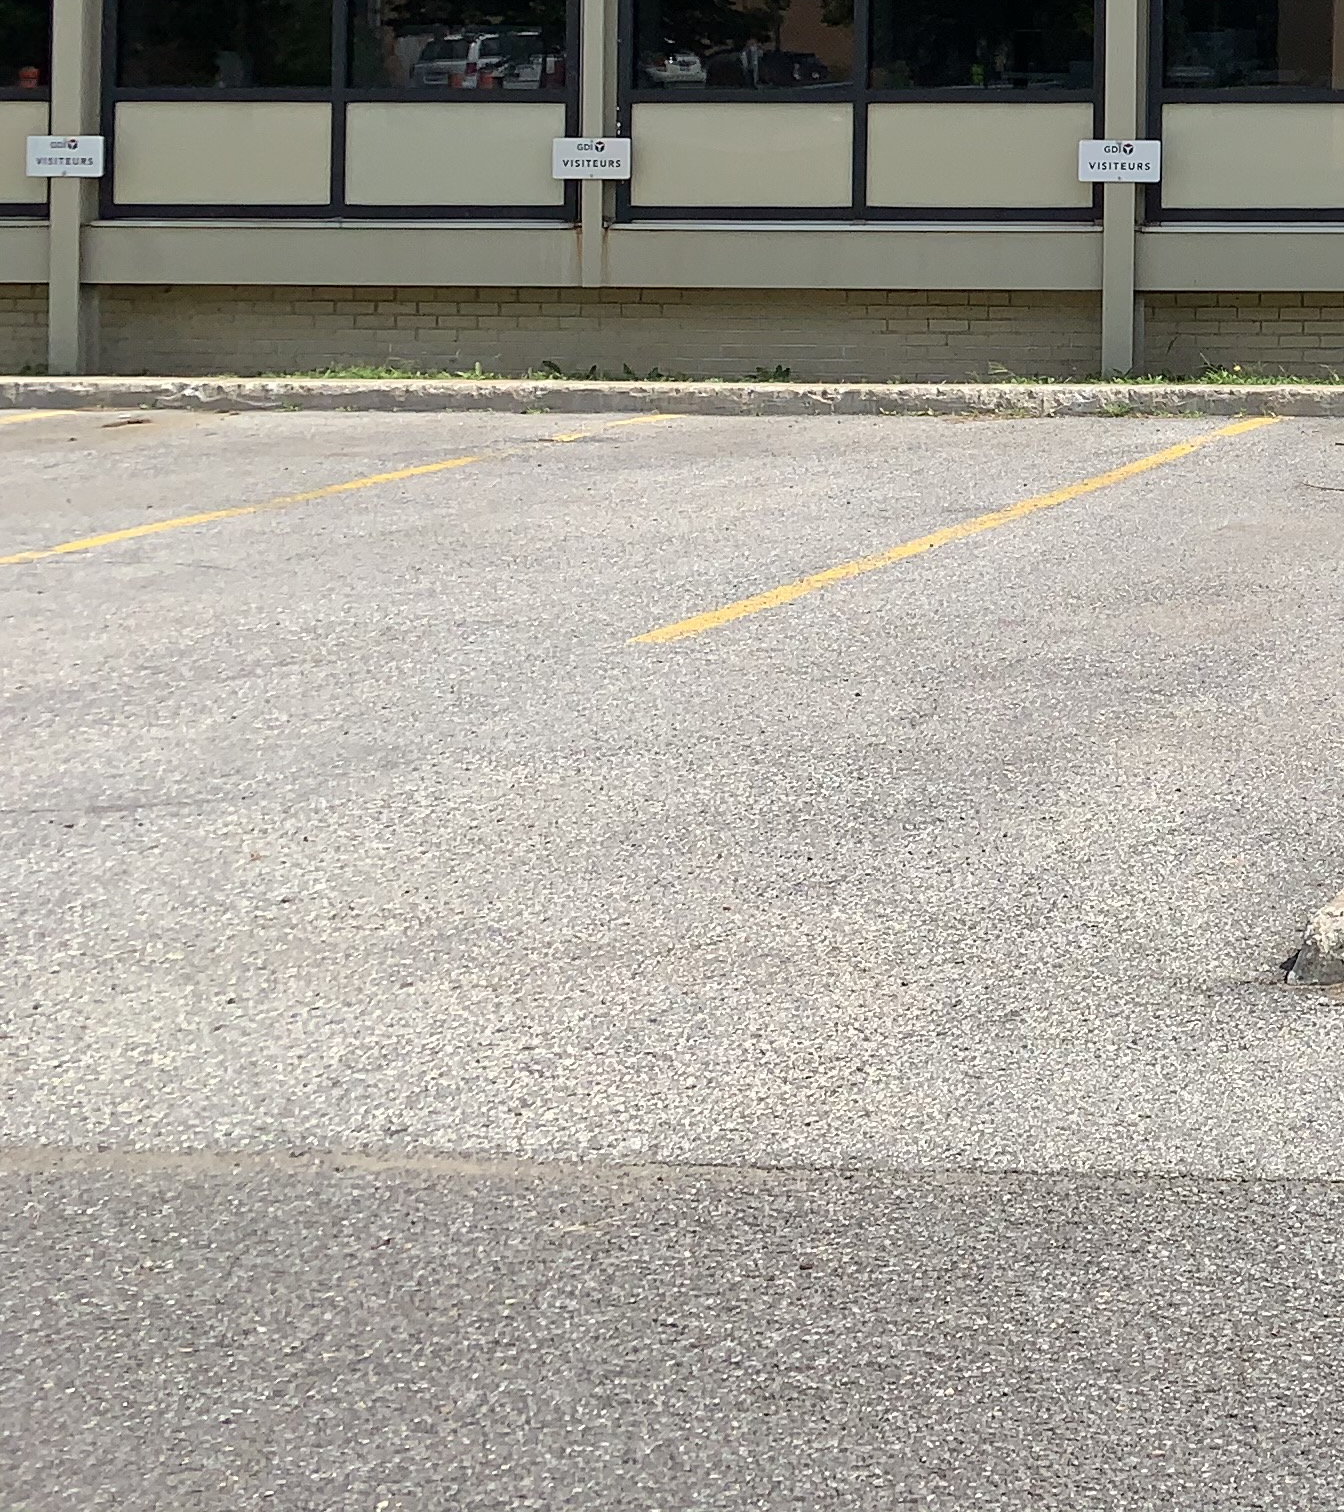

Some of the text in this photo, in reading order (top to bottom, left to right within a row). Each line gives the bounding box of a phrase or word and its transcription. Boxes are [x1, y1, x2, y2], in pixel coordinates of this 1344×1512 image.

[36, 157, 94, 166] VISITEURS
[562, 159, 621, 168] VISITEURS
[1088, 161, 1151, 171] VISITEURS
